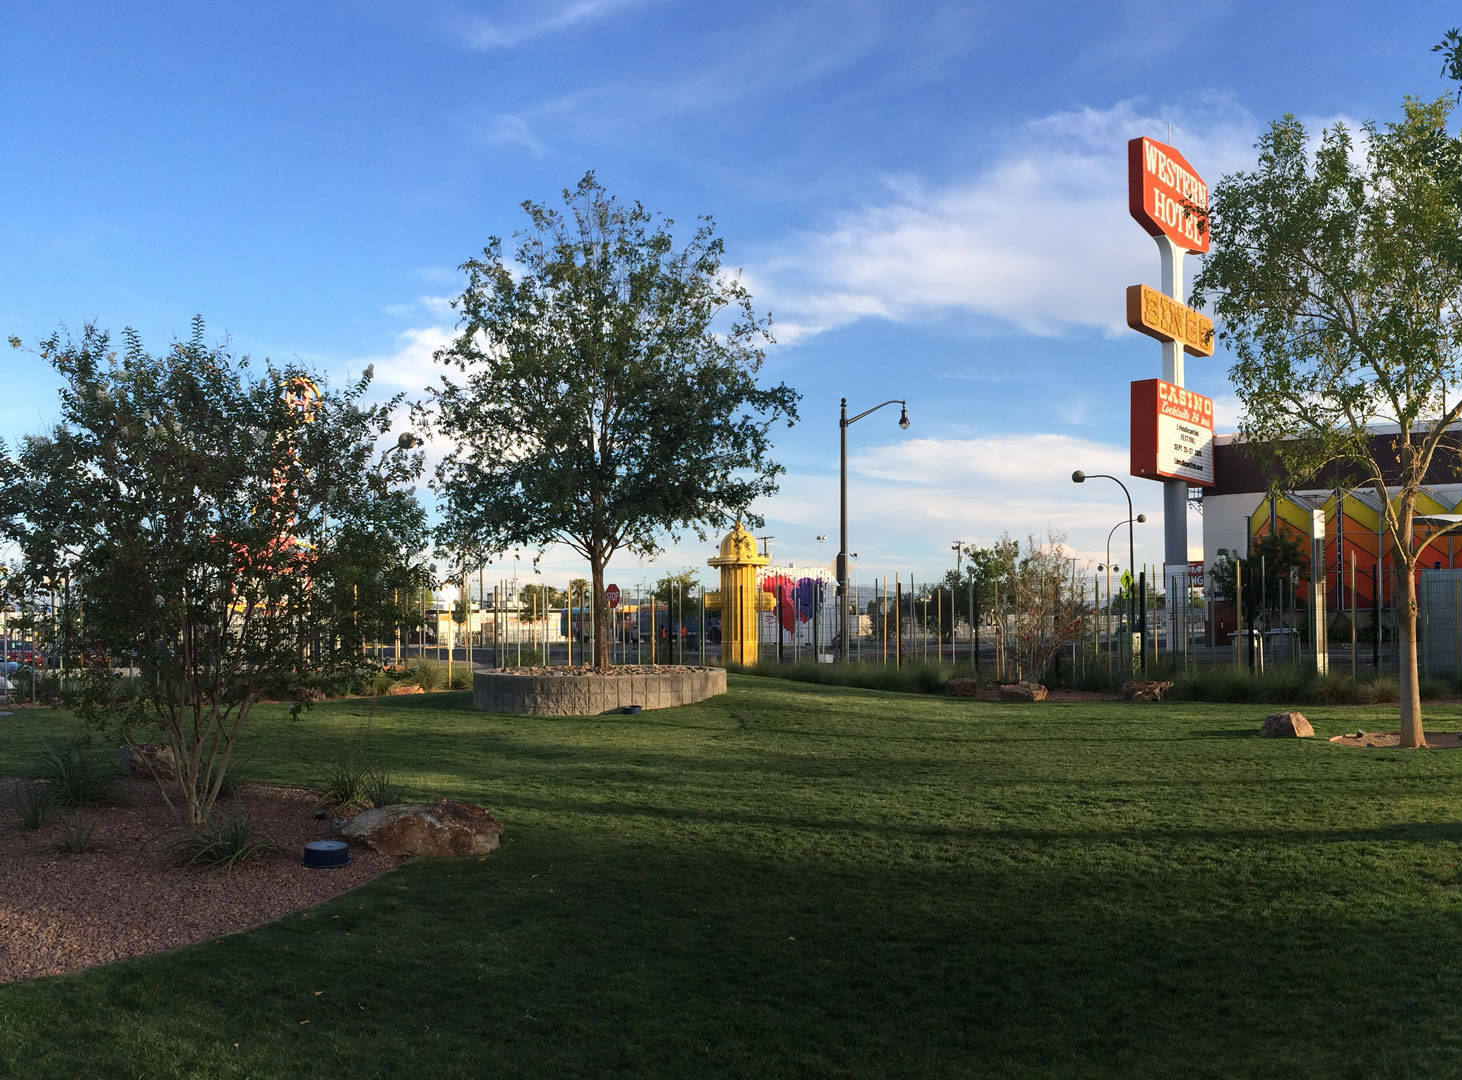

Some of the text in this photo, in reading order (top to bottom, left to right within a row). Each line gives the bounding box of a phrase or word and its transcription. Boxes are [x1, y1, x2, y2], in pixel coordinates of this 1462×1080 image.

[1144, 140, 1207, 209] WESTERN
[1154, 187, 1202, 246] HOTEL
[1159, 382, 1212, 415] CASINO
[606, 591, 619, 601] STOP
